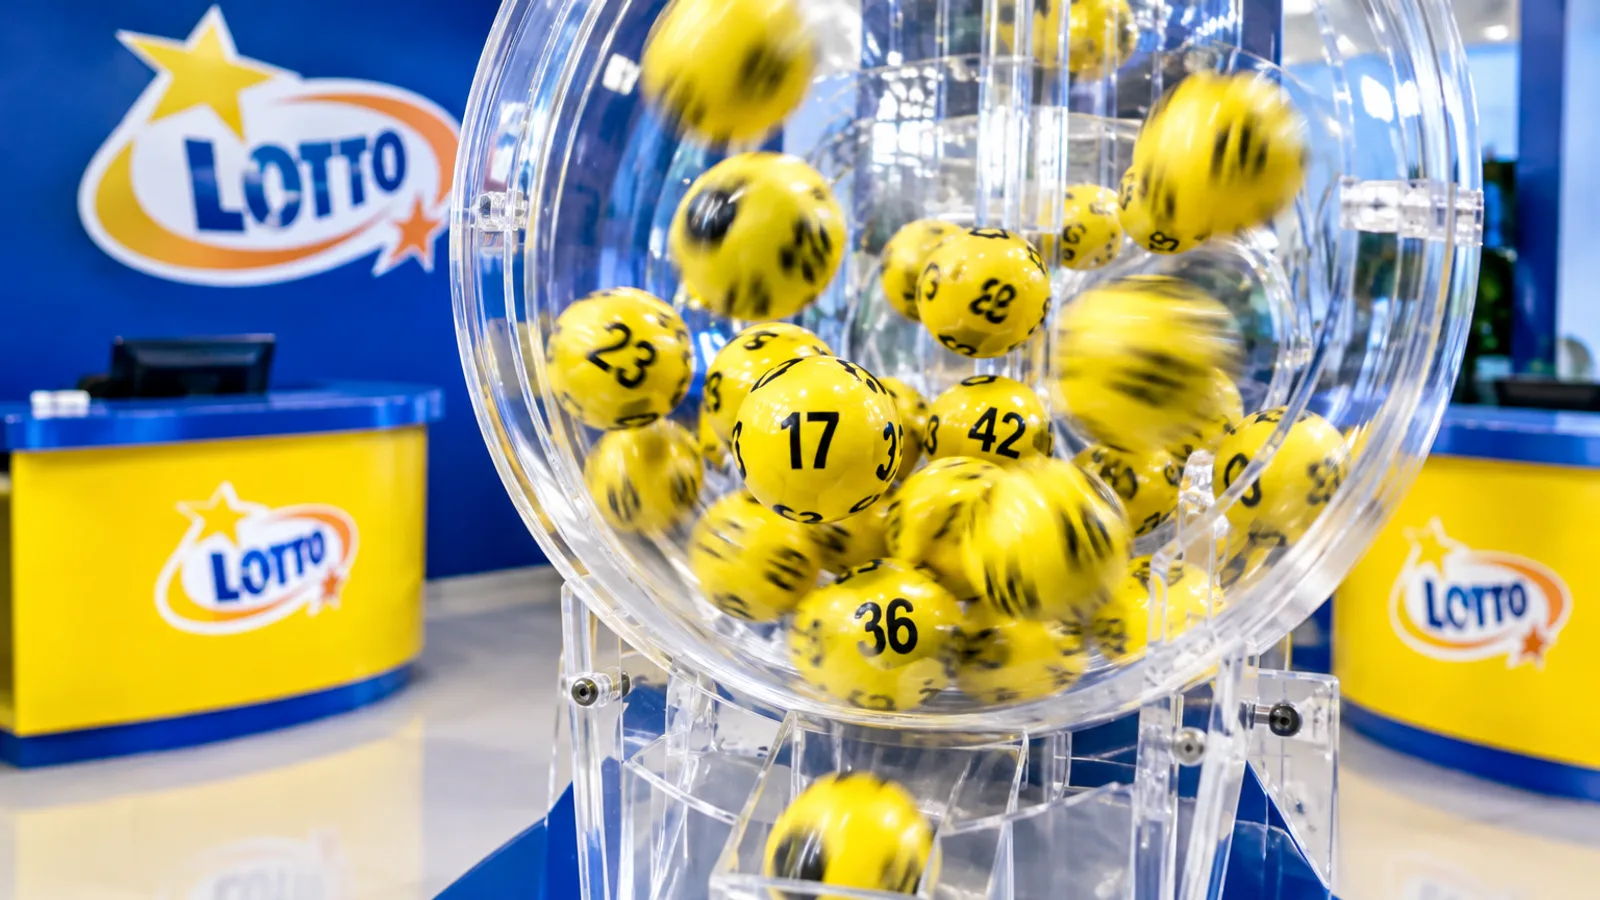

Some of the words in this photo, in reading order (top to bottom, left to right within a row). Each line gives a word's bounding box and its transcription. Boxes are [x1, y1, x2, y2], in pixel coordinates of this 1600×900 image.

[184, 128, 407, 233] LOTTO
[586, 322, 656, 389] 23
[780, 411, 840, 470] 17
[967, 406, 1026, 460] 42
[210, 529, 326, 603] LOTTO
[854, 597, 918, 656] 36
[1424, 579, 1528, 630] LOTTO
